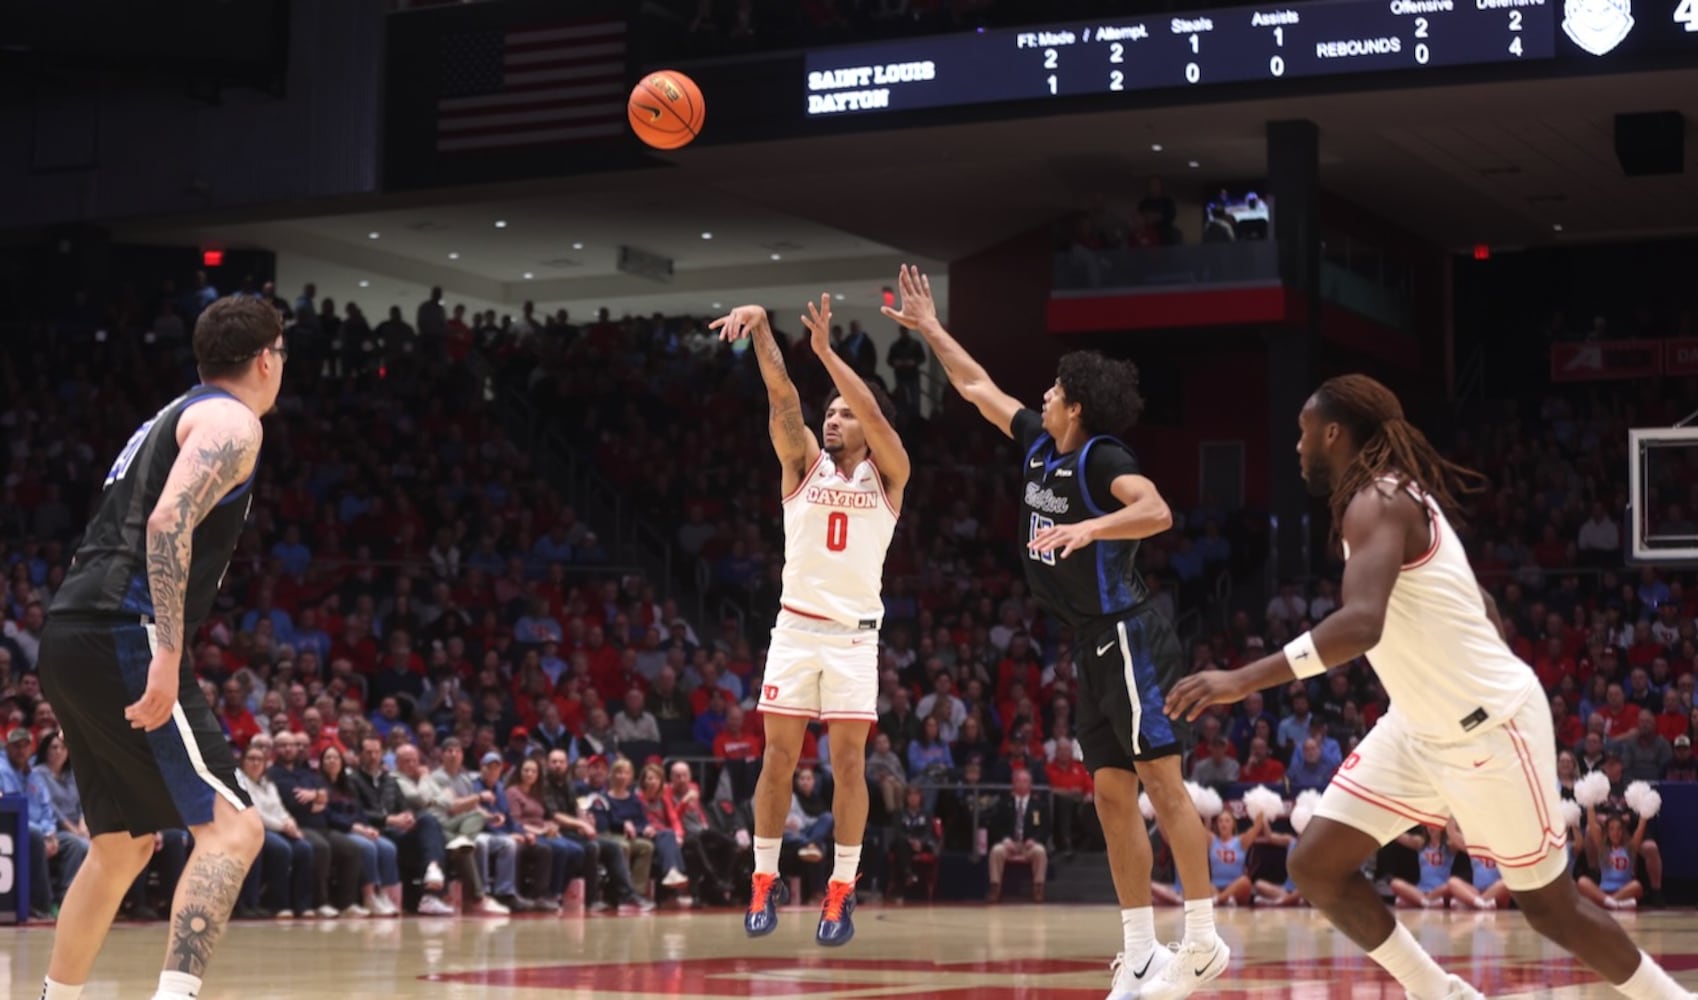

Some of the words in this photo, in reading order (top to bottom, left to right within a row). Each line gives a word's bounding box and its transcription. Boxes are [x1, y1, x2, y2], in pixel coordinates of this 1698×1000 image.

[1171, 17, 1213, 34] Steals
[1251, 9, 1299, 27] Assists
[1414, 17, 1428, 38] 2
[1508, 9, 1523, 31] 2
[1189, 33, 1199, 54] 1
[1273, 26, 1284, 47] 1
[1316, 36, 1401, 58] REBOUNDS
[1508, 36, 1523, 57] 4
[1044, 48, 1058, 69] 2
[1109, 42, 1124, 63] 2
[1414, 43, 1429, 64] 0
[808, 66, 872, 90] SAINT
[874, 60, 936, 84] LOUIS
[1185, 62, 1200, 84] 0
[1270, 55, 1285, 77] 0
[1047, 73, 1058, 95] 1
[1109, 69, 1124, 91] 2
[808, 88, 890, 114] DAYTON
[806, 486, 878, 509] DAYTON
[826, 511, 848, 552] 0
